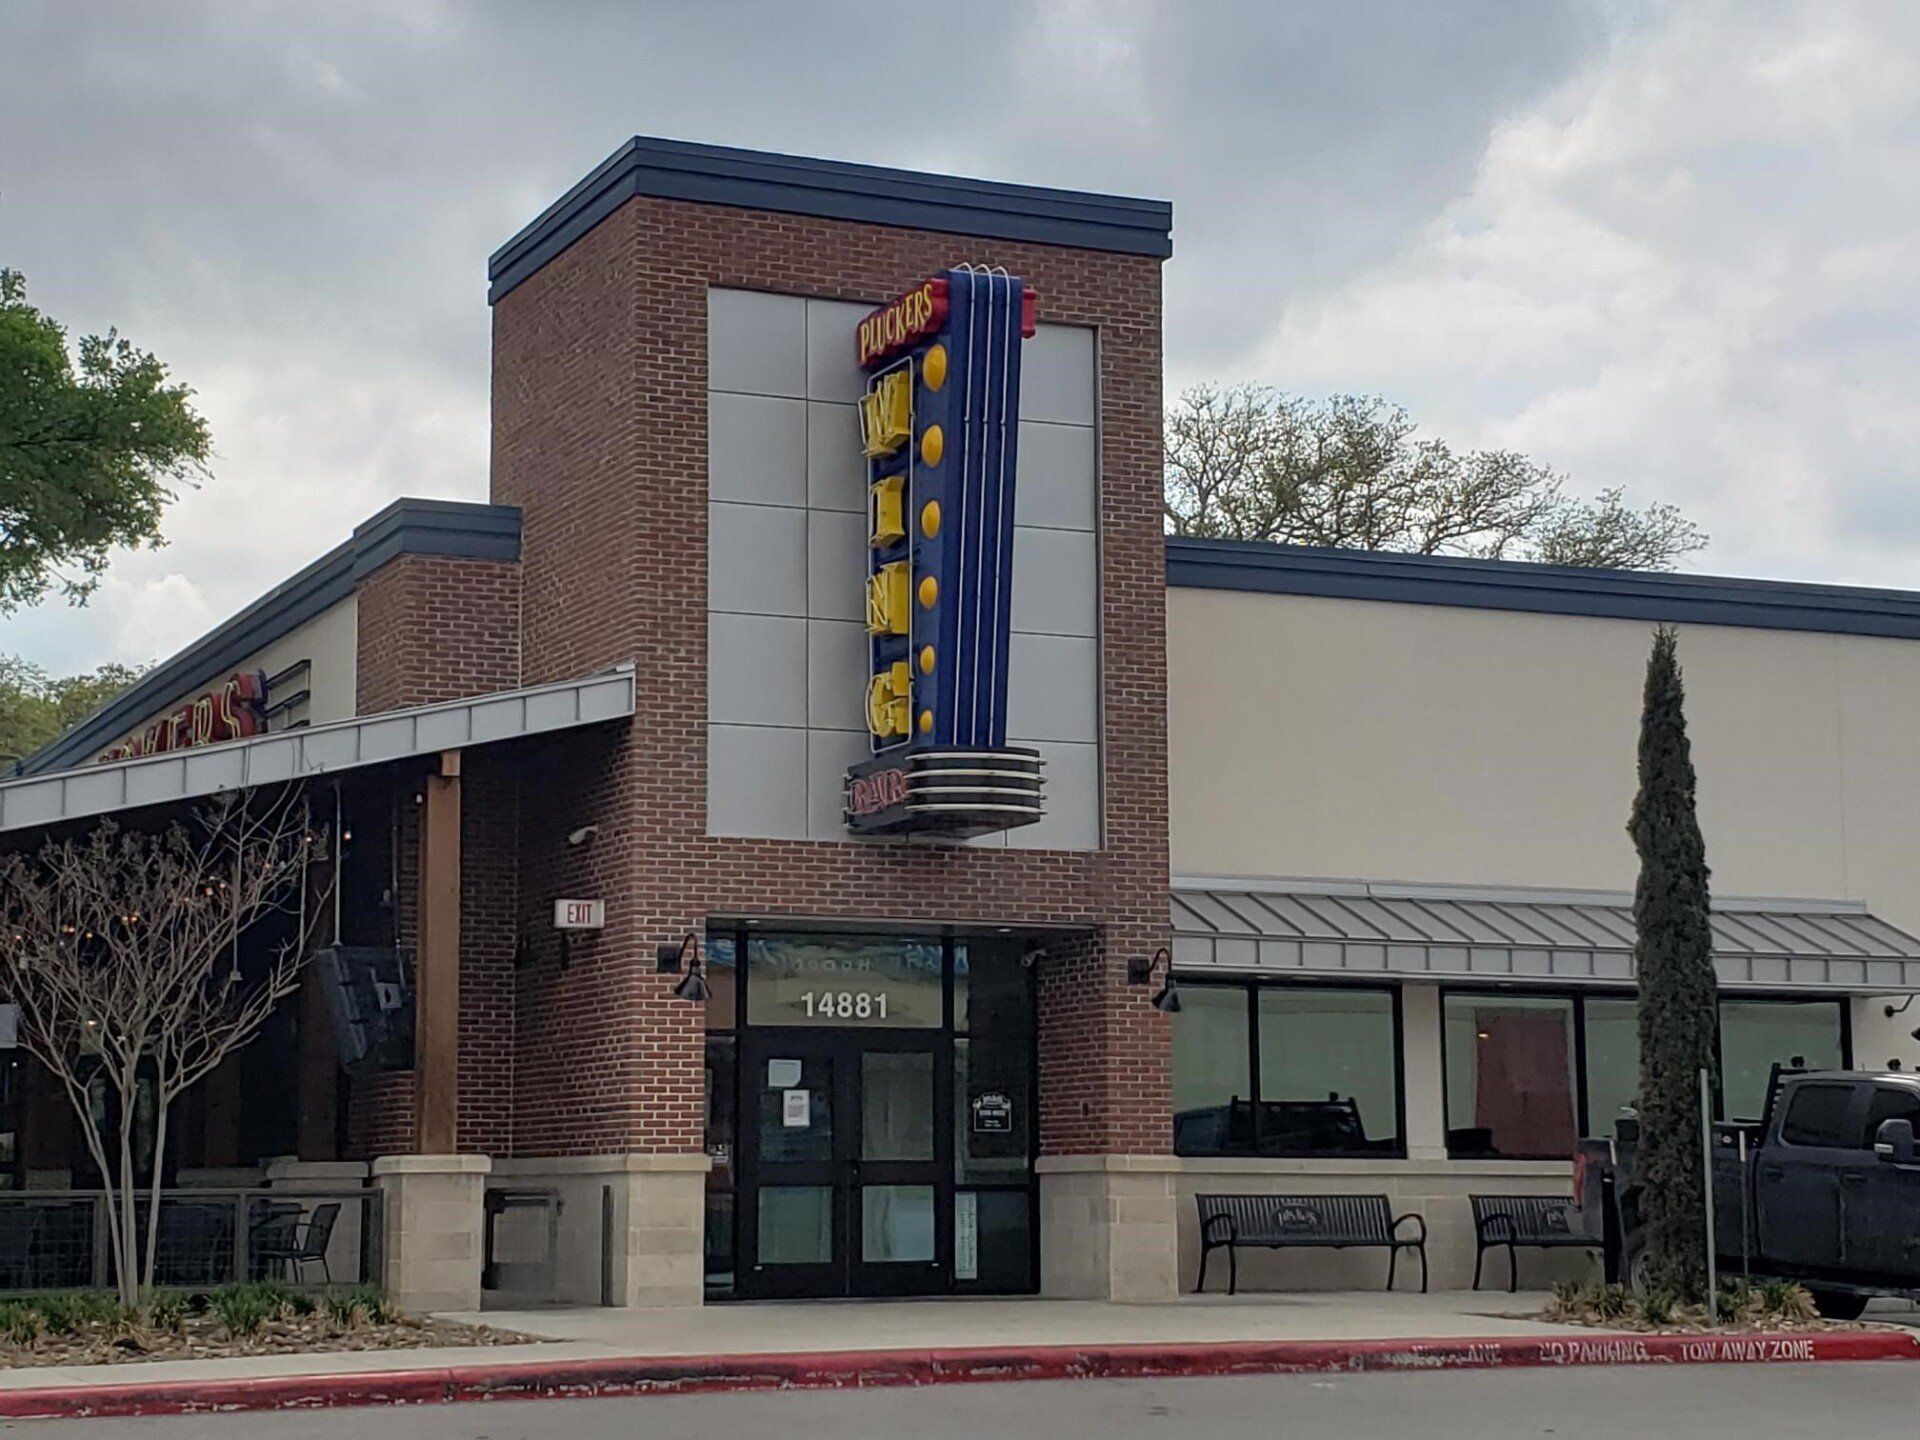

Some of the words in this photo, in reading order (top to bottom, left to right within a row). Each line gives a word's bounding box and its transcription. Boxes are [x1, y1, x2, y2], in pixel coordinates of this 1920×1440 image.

[859, 283, 932, 365] PLUCKERS
[848, 768, 906, 815] BAR
[567, 903, 593, 924] EXIT
[800, 991, 888, 1019] 14881
[1567, 1341, 1650, 1363] PARKING
[1680, 1342, 1716, 1361] TOW
[1721, 1341, 1766, 1361] AWAY
[1770, 1340, 1815, 1360] ZONE
